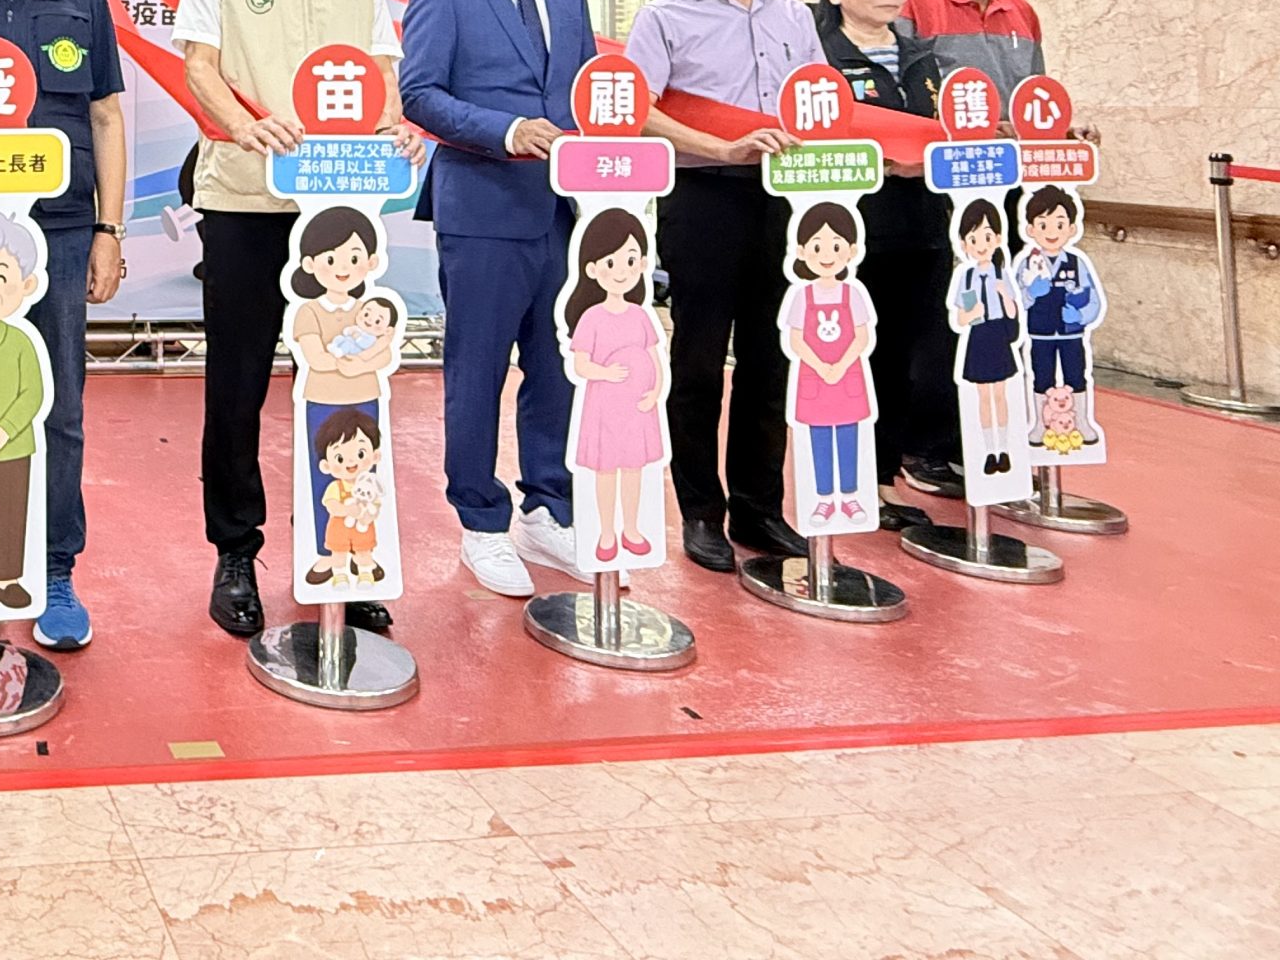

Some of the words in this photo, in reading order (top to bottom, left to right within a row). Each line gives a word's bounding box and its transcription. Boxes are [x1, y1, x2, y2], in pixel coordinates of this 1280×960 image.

[311, 60, 367, 122] 苗
[588, 71, 636, 126] 顧
[794, 77, 840, 131] 肺
[951, 80, 991, 130] 護
[1023, 87, 1062, 130] 心
[298, 159, 387, 175] 滿6個月以上至
[596, 155, 633, 178] 孕婦
[772, 167, 877, 185] 及居家托育專業人員
[780, 152, 869, 168] 幼兒園、托育機構
[295, 176, 390, 192] 國小入學前幼兒
